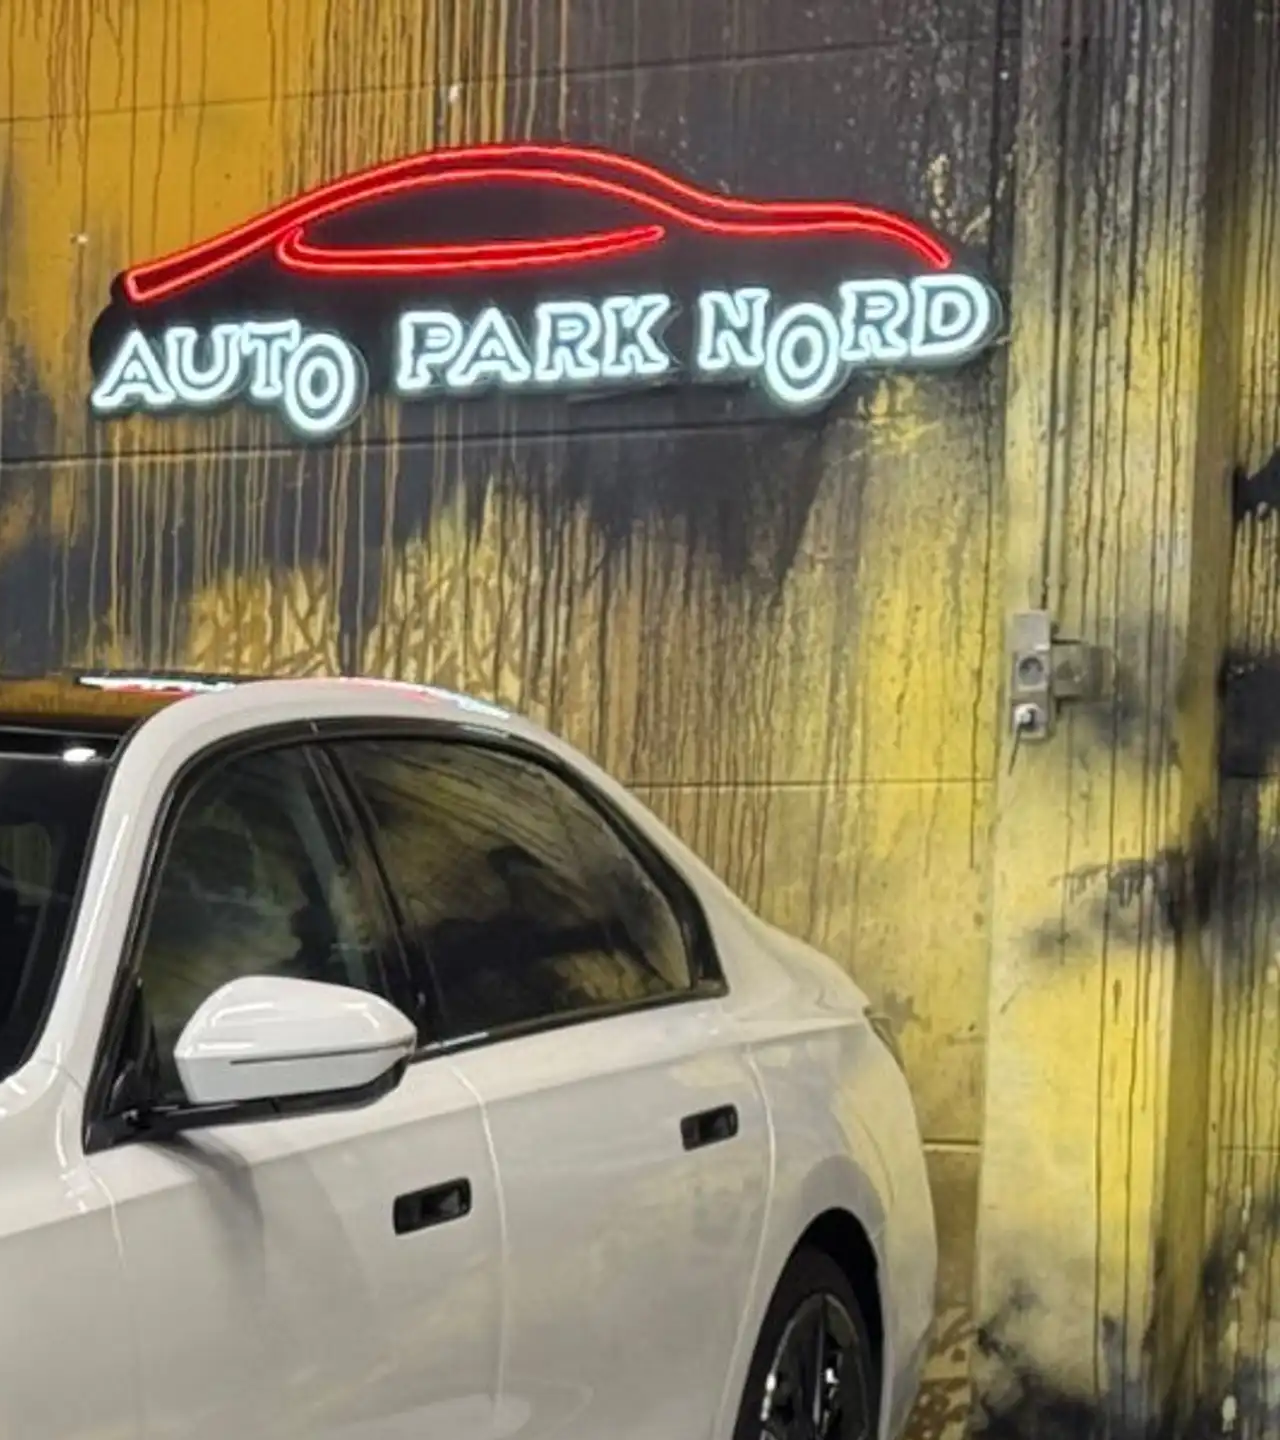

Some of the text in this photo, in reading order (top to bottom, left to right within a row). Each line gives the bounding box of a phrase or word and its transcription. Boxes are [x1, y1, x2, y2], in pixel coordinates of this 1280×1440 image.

[92, 272, 992, 431] AUTO PARK NORD
